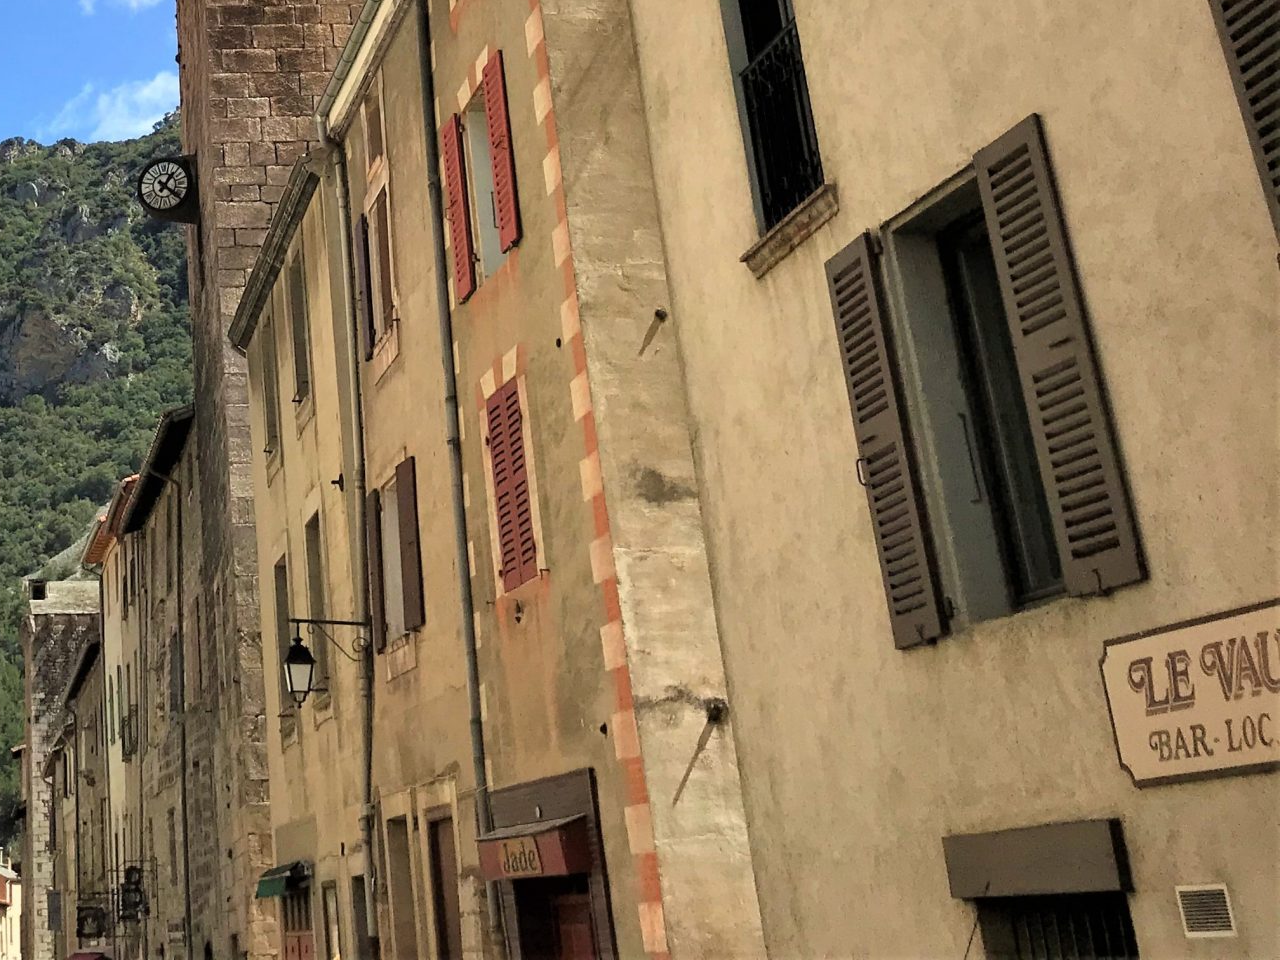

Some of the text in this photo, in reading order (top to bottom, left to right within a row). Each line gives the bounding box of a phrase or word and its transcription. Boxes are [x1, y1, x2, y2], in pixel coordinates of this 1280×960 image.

[1128, 628, 1280, 716] LE VAU
[1149, 712, 1280, 762] BAR LOC
[503, 840, 537, 873] Jade
